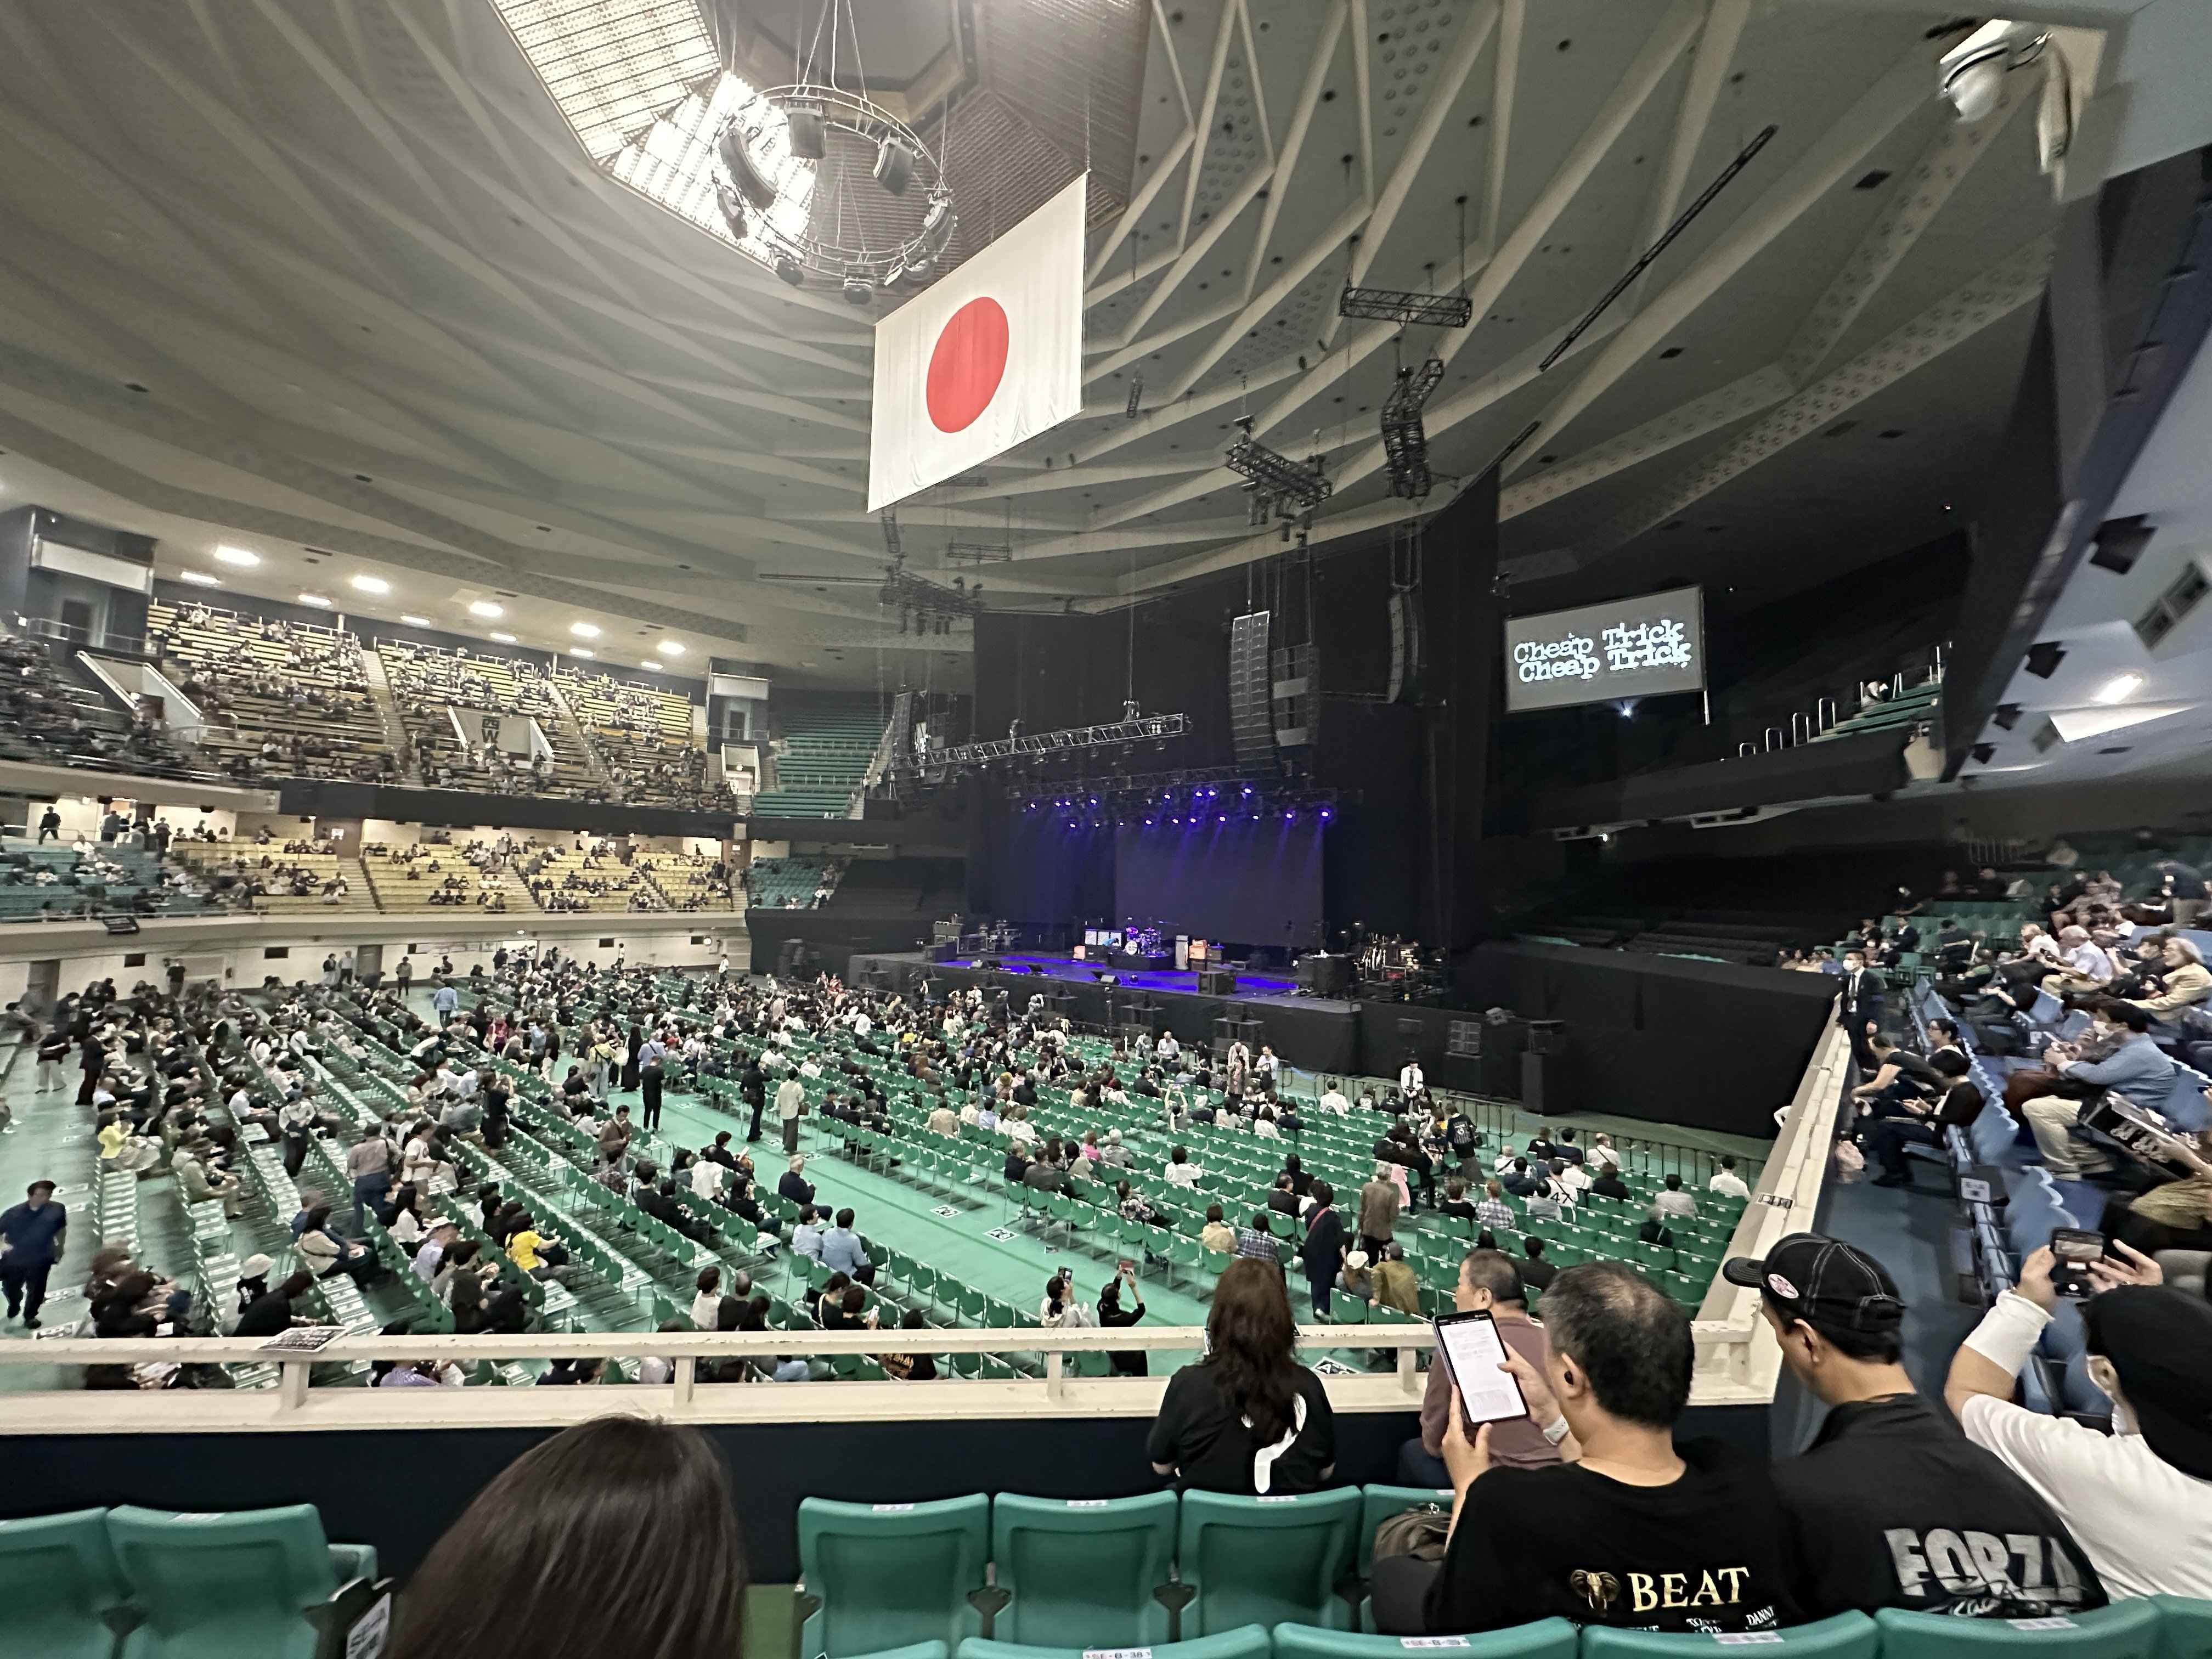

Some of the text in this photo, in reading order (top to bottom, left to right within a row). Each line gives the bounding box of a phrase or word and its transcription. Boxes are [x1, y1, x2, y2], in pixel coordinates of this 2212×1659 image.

[1514, 619, 1685, 664] Cheap Trick
[1519, 642, 1691, 682] Cheap Trick
[481, 729, 500, 743] W
[482, 715, 500, 730] 西
[1627, 1566, 1751, 1612] BEAT
